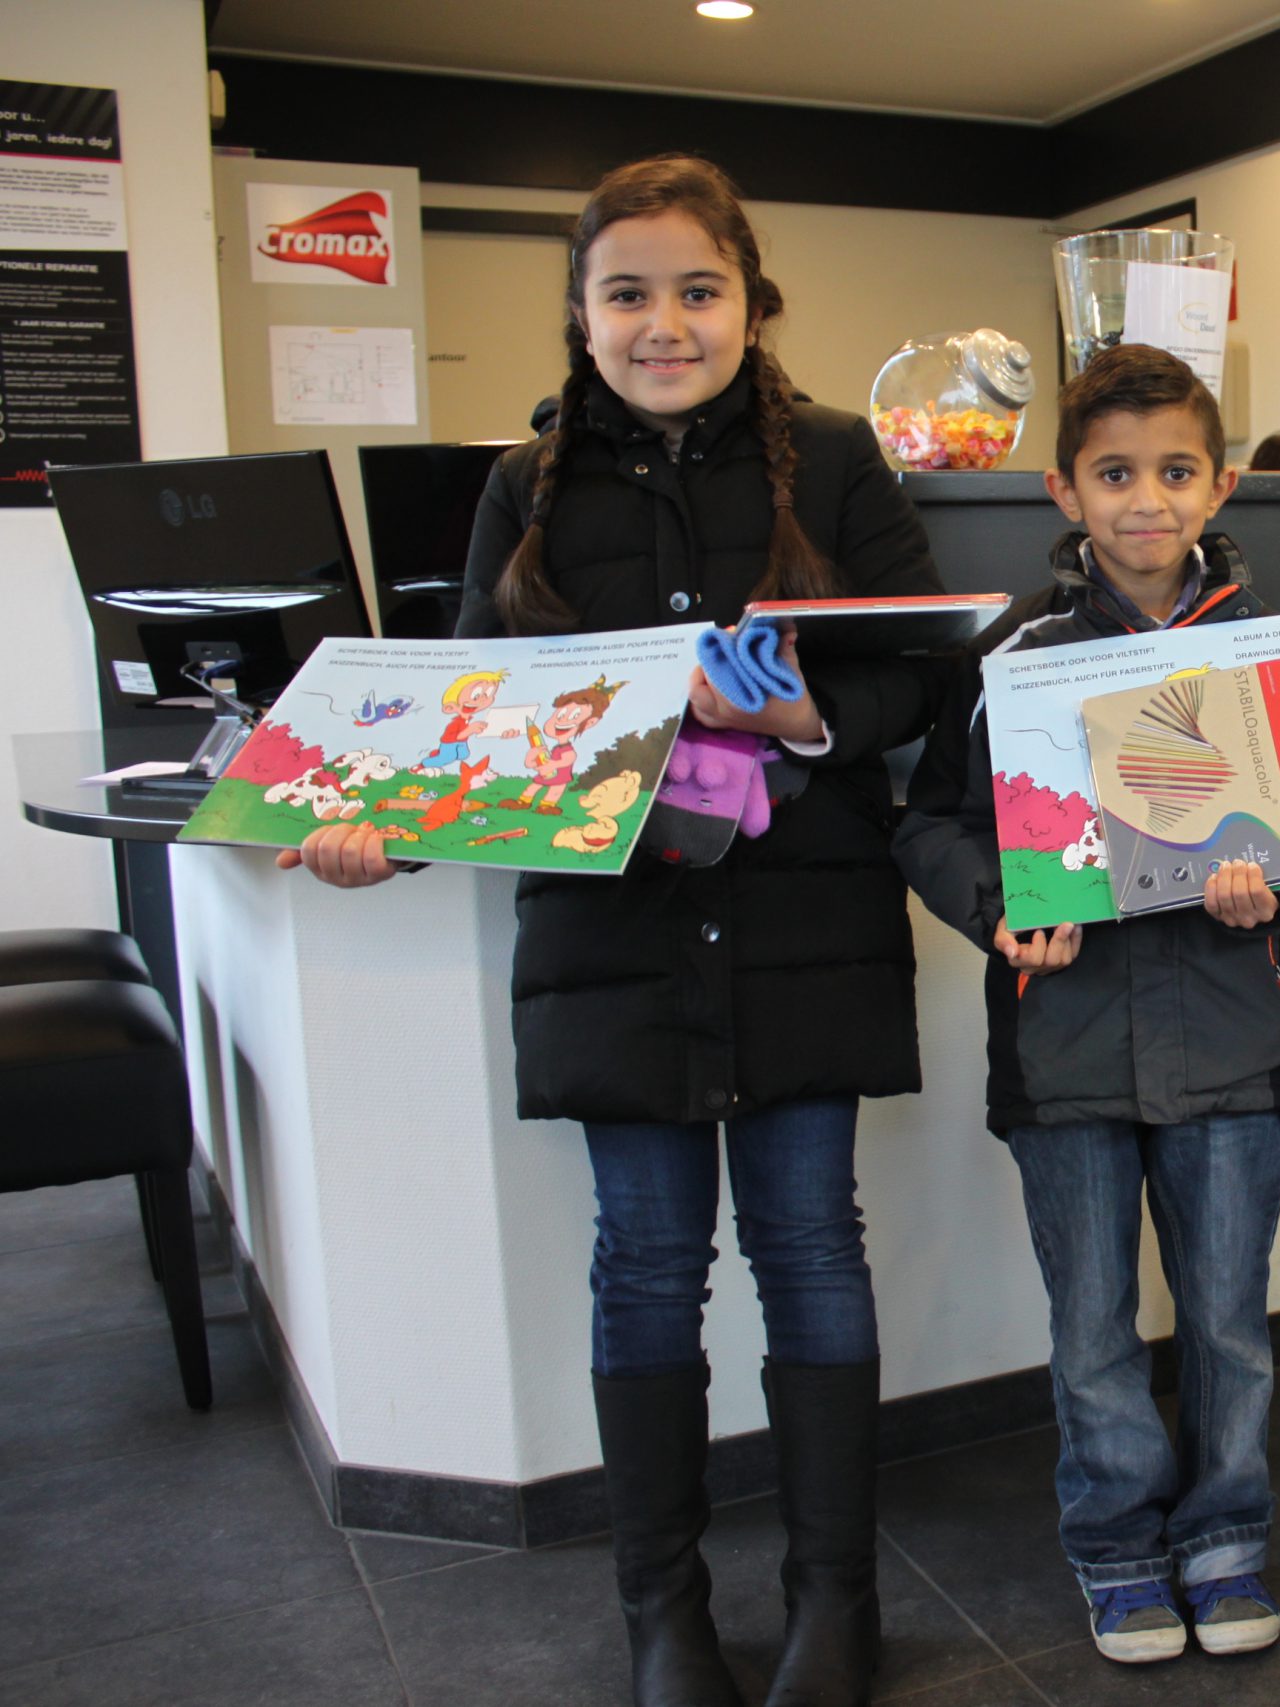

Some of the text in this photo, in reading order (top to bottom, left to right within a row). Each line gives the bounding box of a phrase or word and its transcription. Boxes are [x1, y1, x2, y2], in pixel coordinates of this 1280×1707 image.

[47, 133, 84, 146] iedere
[260, 226, 387, 257] Cromax
[428, 353, 467, 362] antoor
[188, 493, 217, 518] LG
[1233, 632, 1262, 643] ALBUM
[1264, 630, 1271, 638] A
[338, 648, 388, 656] SCHETSBOEK
[537, 647, 565, 655] ALBUM
[573, 645, 601, 653] DESSIN
[626, 641, 649, 649] POUR
[650, 637, 685, 647] FEUTRES
[530, 660, 589, 669] DRAWINGBOOK
[590, 658, 611, 667] ALSO
[613, 656, 630, 664] FOR
[1008, 647, 1156, 674] SCHETSBOEK OOK VOOR VILTSTIFT
[1074, 672, 1098, 683] AUCH
[1100, 669, 1117, 679] FÜR
[1119, 662, 1175, 676] FASERSTIFTE
[1256, 850, 1270, 864] 24
